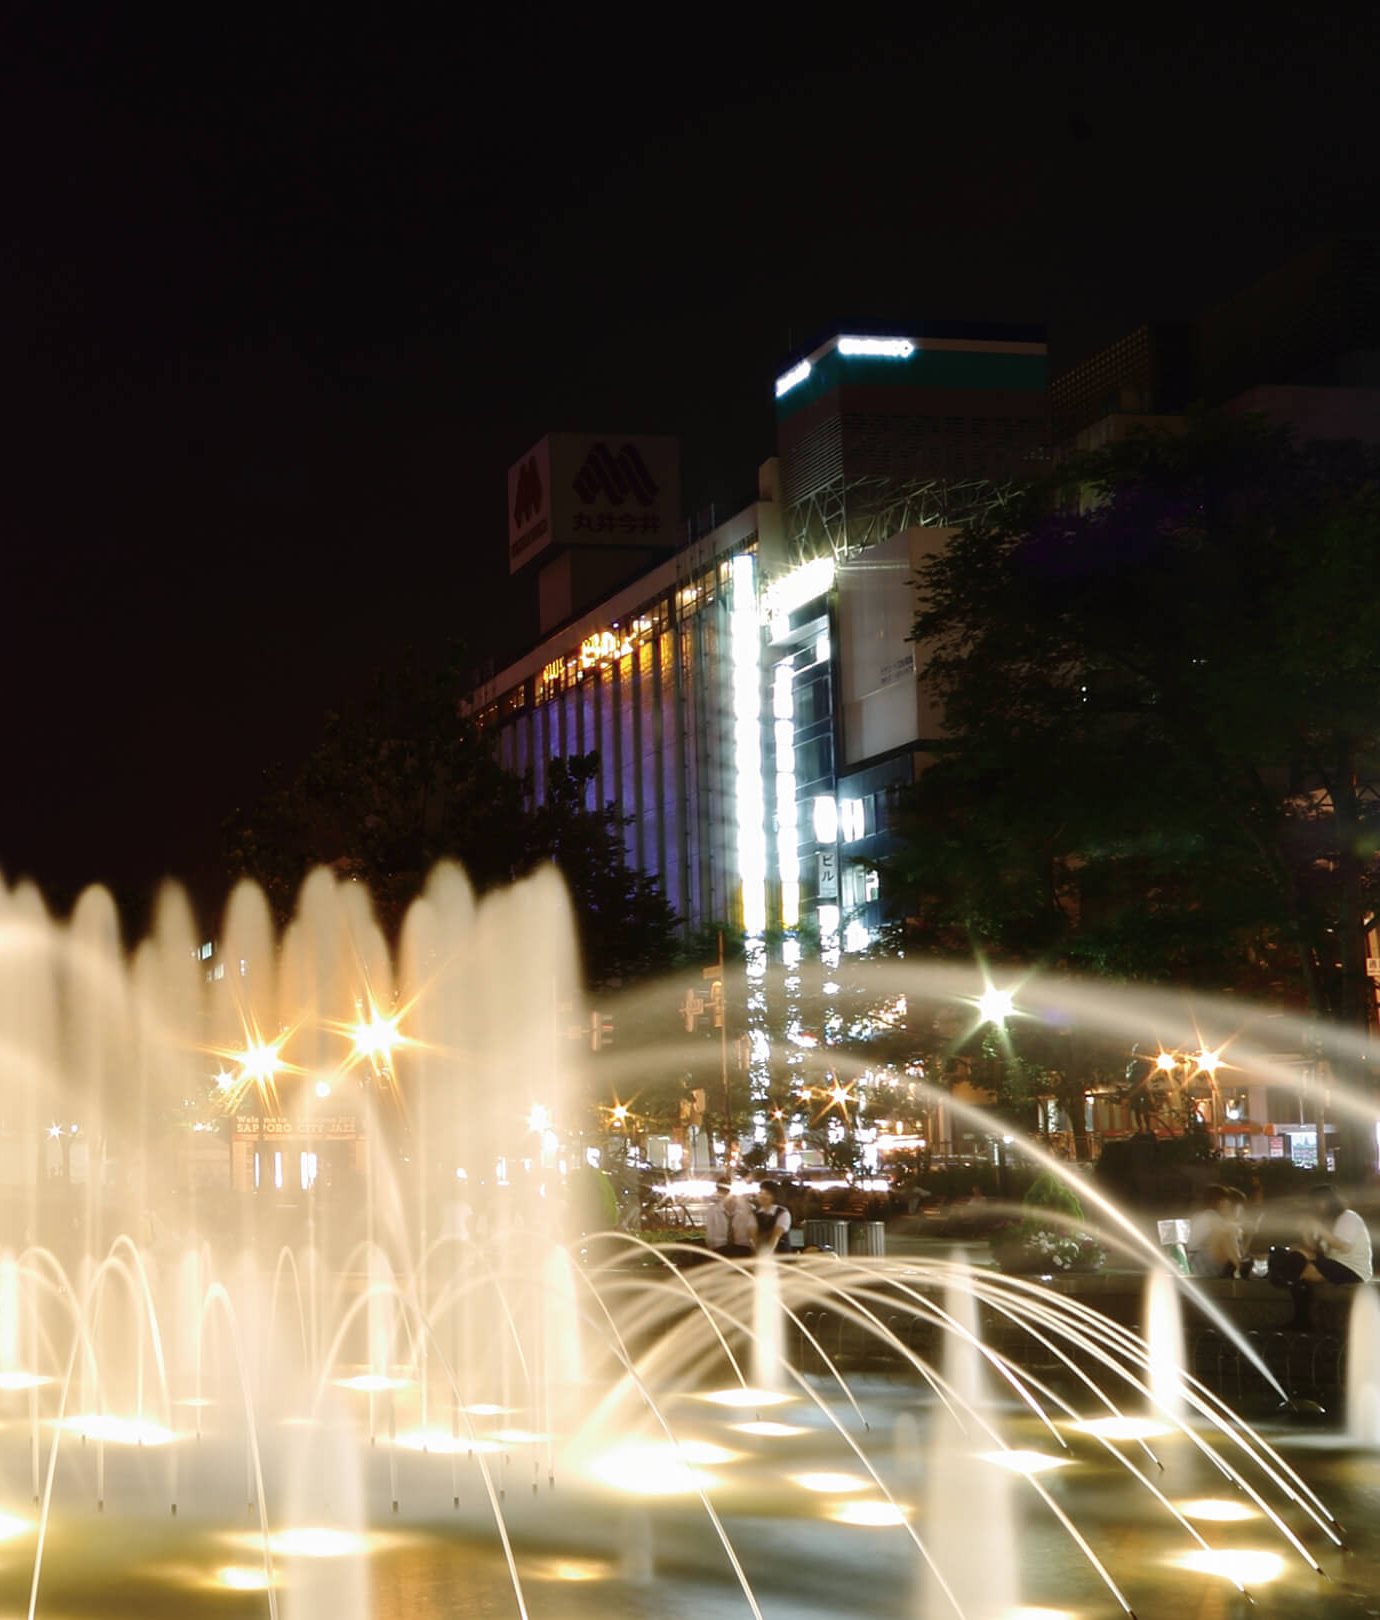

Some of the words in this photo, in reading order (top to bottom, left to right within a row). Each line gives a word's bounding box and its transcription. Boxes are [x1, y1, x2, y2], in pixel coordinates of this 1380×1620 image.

[572, 511, 661, 535] 丸井今井
[822, 854, 834, 883] ビル
[236, 1115, 276, 1123] Welcme
